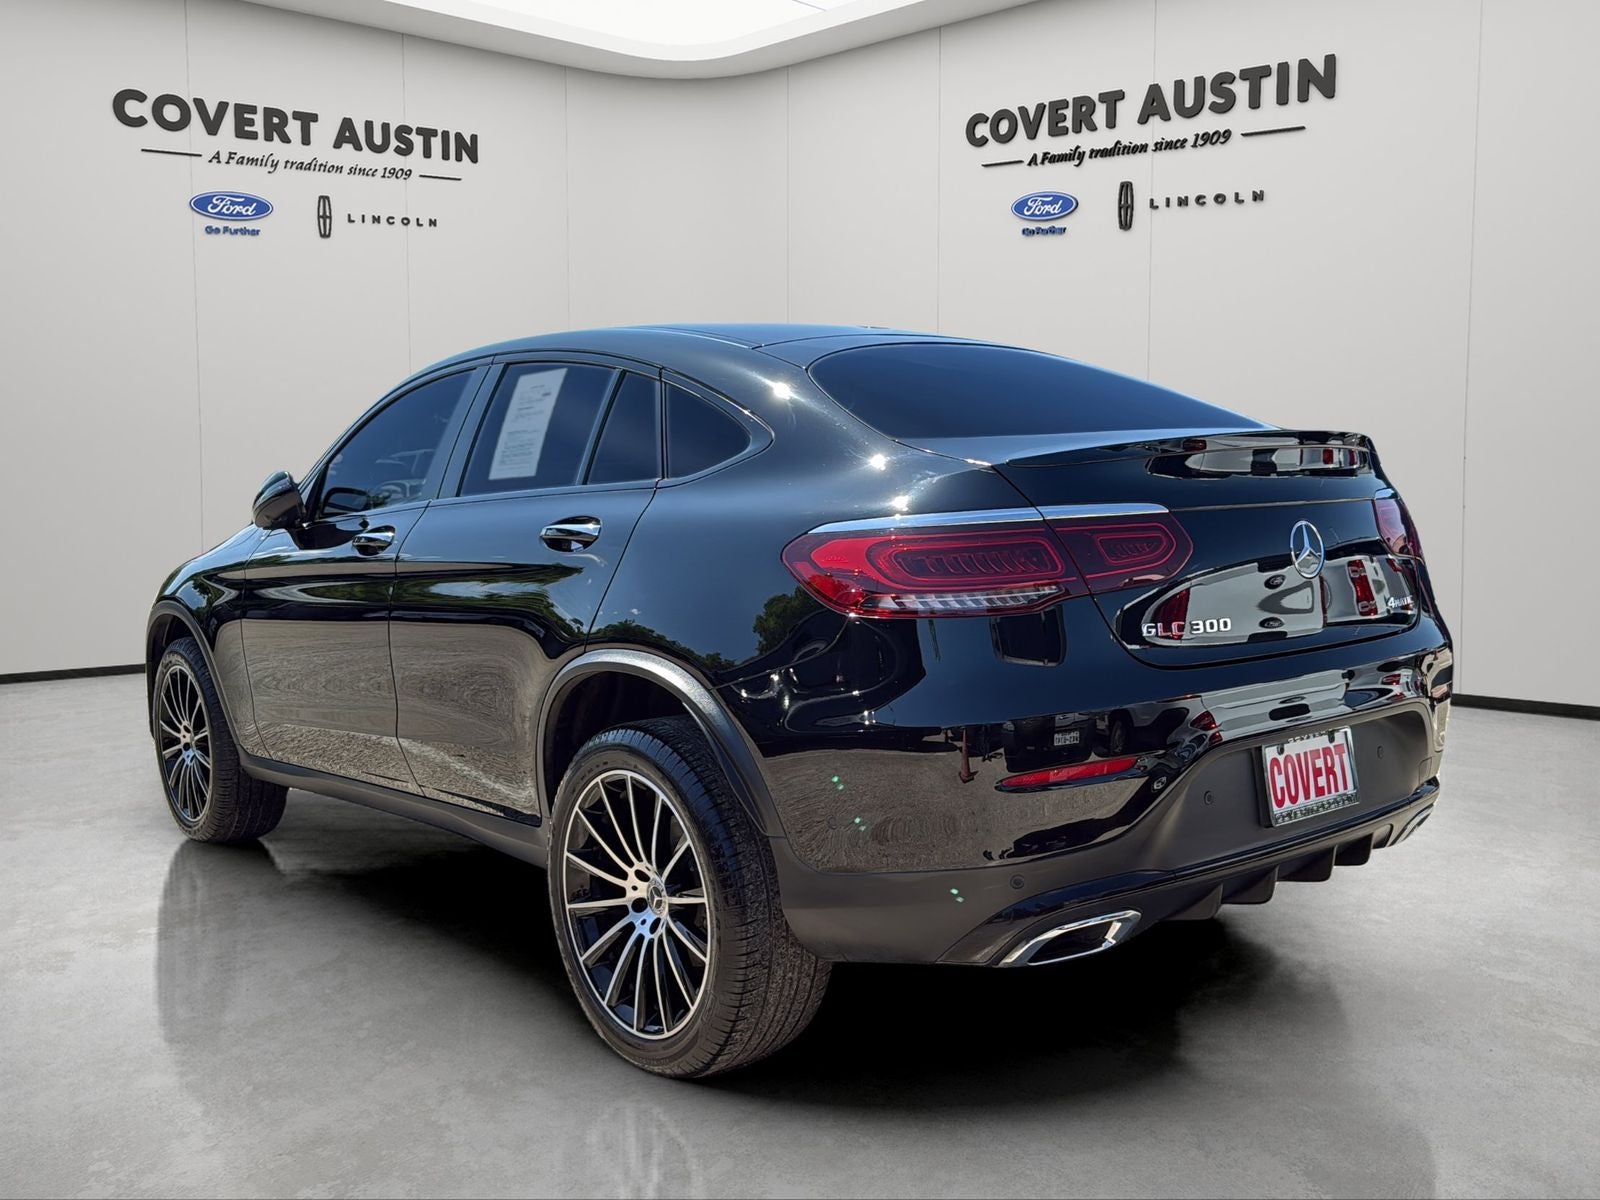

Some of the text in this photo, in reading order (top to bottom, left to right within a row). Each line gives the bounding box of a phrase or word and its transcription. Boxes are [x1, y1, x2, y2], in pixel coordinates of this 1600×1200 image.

[965, 54, 1337, 147] COVERT AUSTIN
[112, 88, 479, 164] COVERT AUSTIN
[1027, 129, 1232, 167] A Family tradition since 1909
[208, 151, 412, 180] A Family tradition since 1909
[208, 194, 257, 216] Ford
[1024, 196, 1062, 216] Ford
[1149, 189, 1266, 210] LINCOLN
[205, 225, 261, 236] Go Further
[348, 213, 437, 228] LINCOLN
[1142, 617, 1232, 638] GLC 300
[1269, 743, 1350, 809] COVERT
